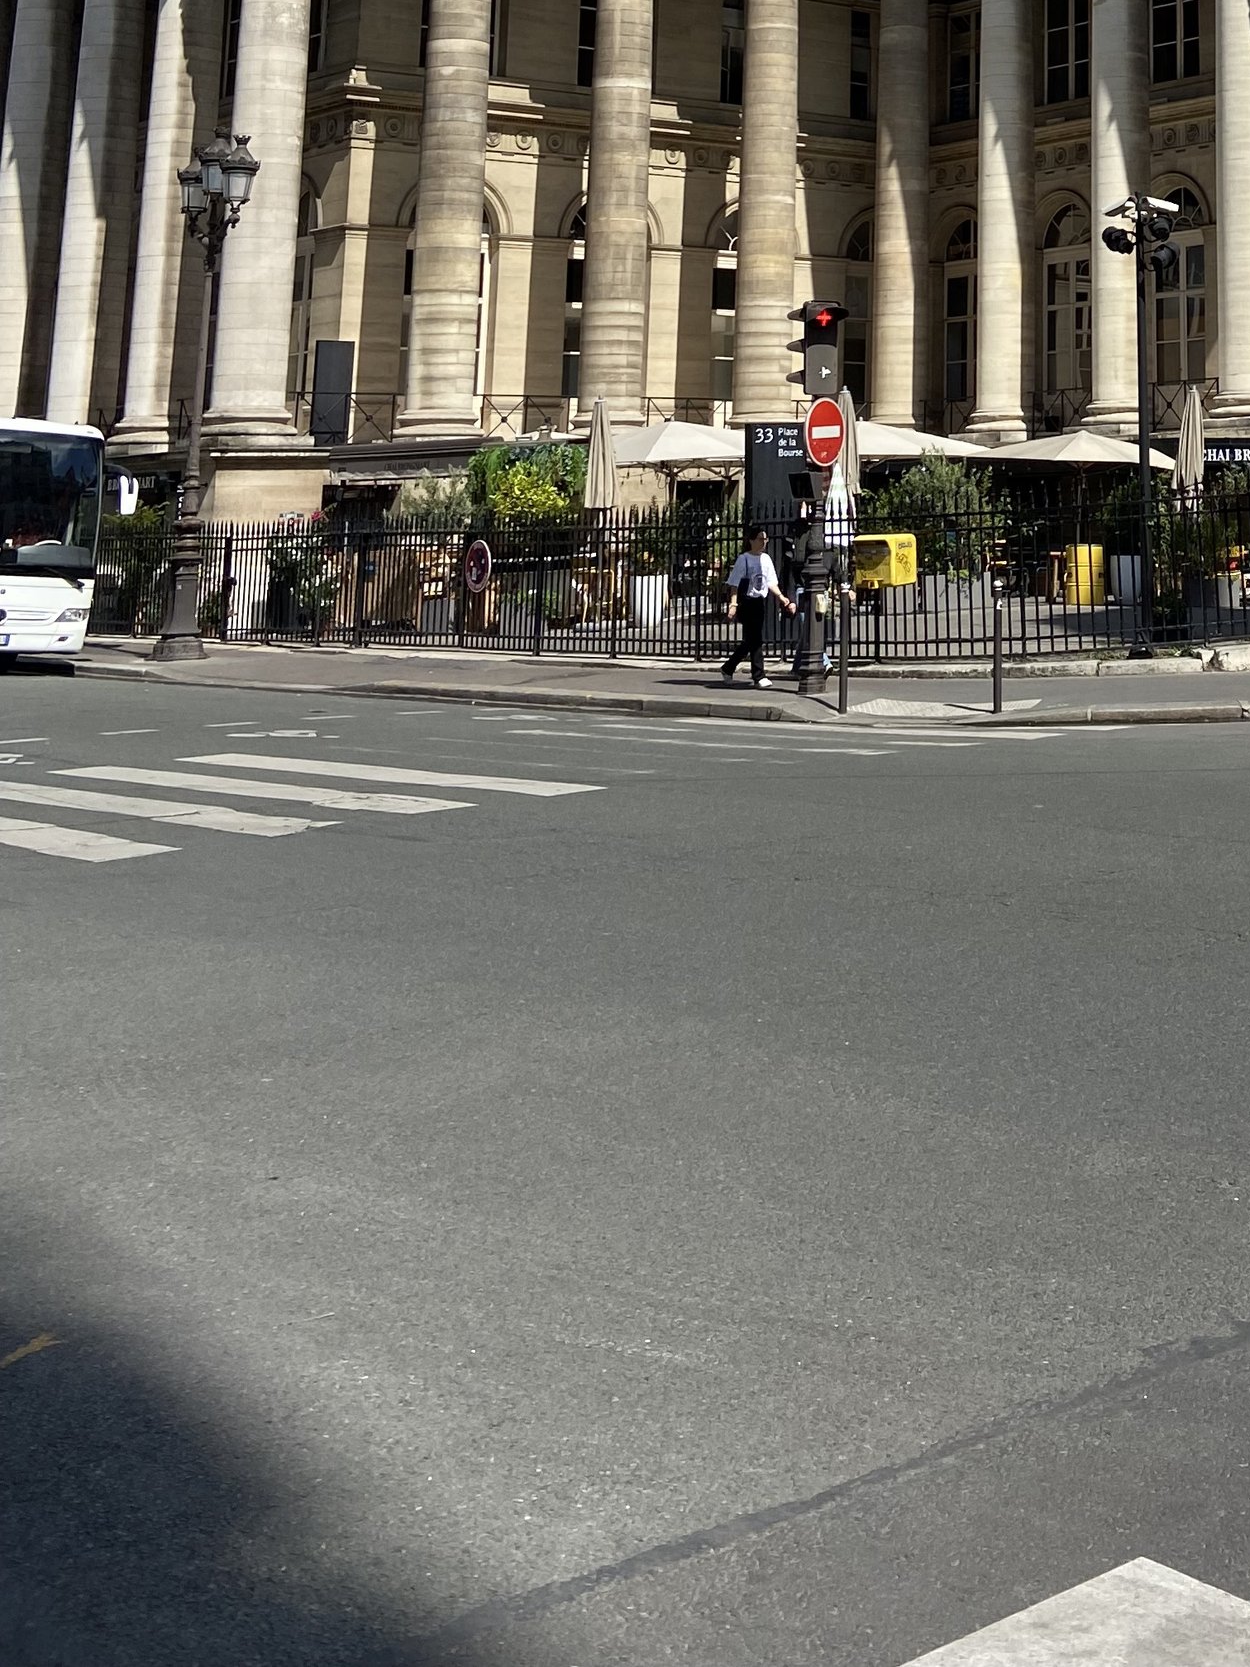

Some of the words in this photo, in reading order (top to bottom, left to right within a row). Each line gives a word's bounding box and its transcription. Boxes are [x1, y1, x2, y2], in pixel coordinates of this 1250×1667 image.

[778, 427, 798, 435] Place
[755, 428, 773, 443] 33
[778, 438, 787, 446] de
[789, 438, 796, 446] la
[778, 448, 803, 457] Bourse
